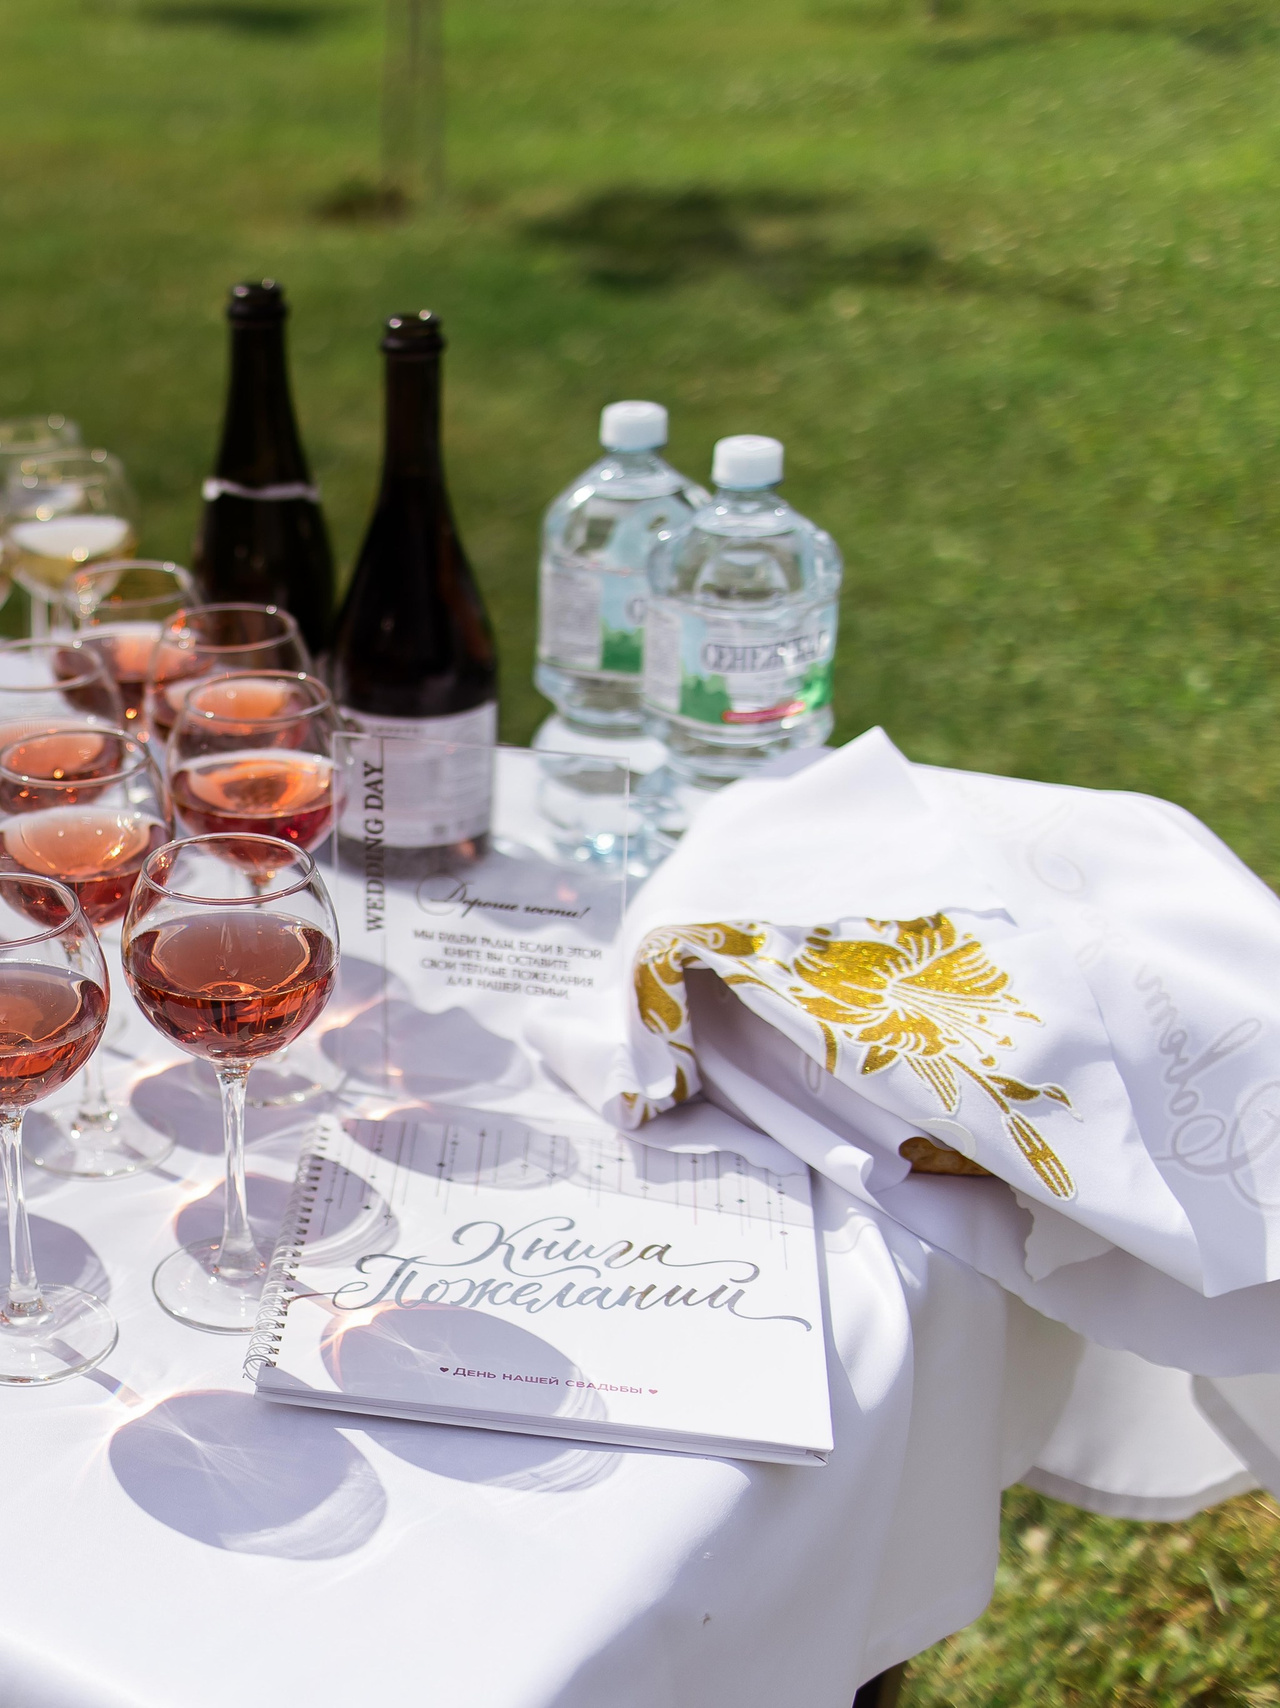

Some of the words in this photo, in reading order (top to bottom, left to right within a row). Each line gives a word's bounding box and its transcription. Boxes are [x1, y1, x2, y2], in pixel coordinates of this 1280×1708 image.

[363, 761, 384, 811] DAY
[365, 818, 385, 932] WEDDING
[507, 955, 570, 969] ОСТАВИТЕ
[519, 941, 553, 954] ЕСЛИ
[557, 946, 564, 955] В
[568, 947, 602, 960] ЭТОЙ
[432, 1216, 760, 1283] Книга
[502, 1373, 559, 1386] НАШЕЙ
[565, 1379, 642, 1394] СВАДЬБЫ
